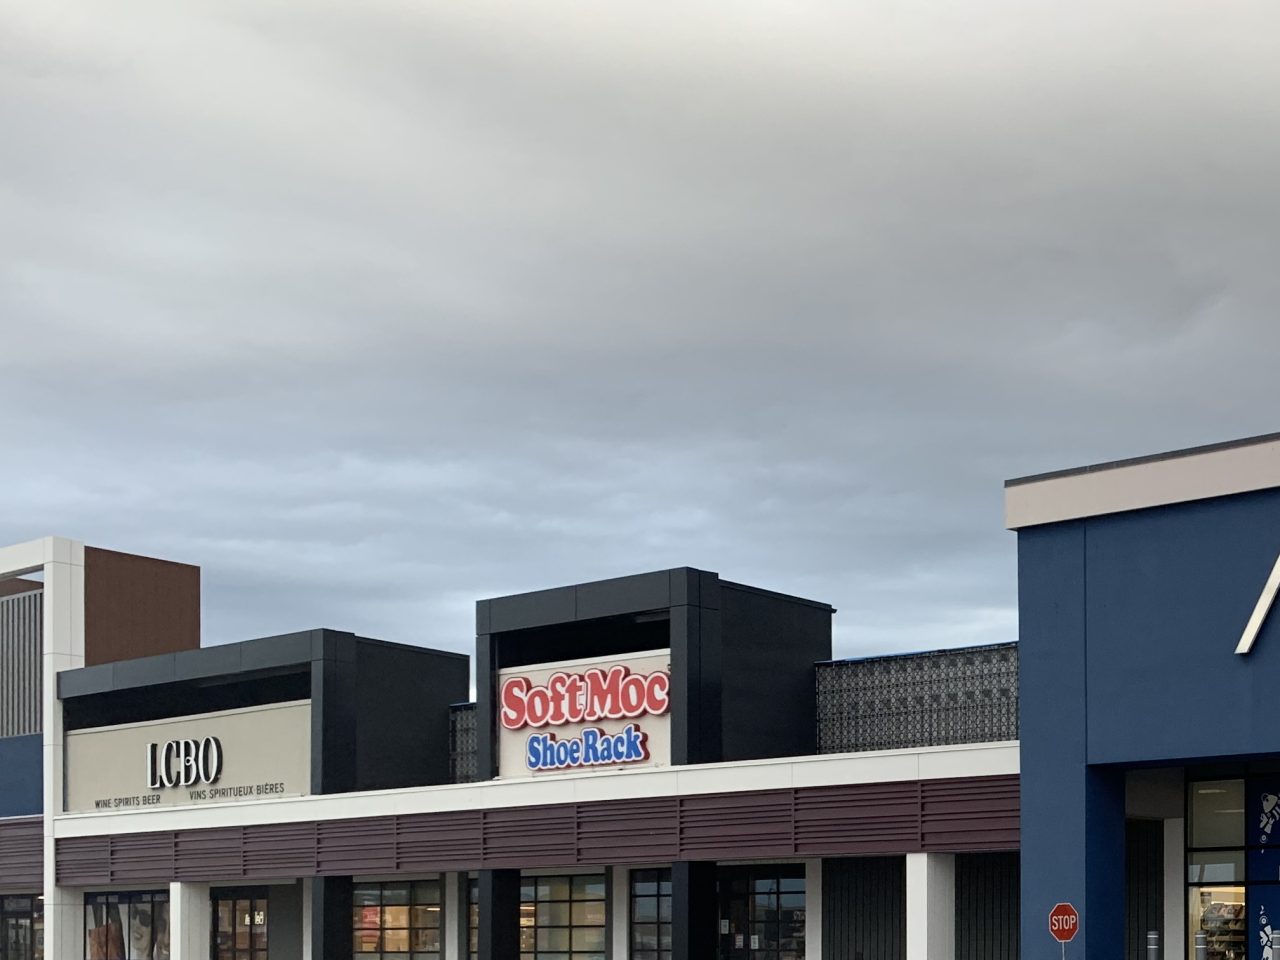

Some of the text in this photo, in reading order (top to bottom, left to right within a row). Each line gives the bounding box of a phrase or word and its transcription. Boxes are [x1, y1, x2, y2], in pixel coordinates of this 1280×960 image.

[146, 736, 223, 790] LCBO
[189, 790, 207, 800] VINS
[209, 785, 254, 799] SPIRITUEUX
[94, 794, 161, 809] WINE SPIRITS BEER
[1052, 915, 1076, 930] STOP
